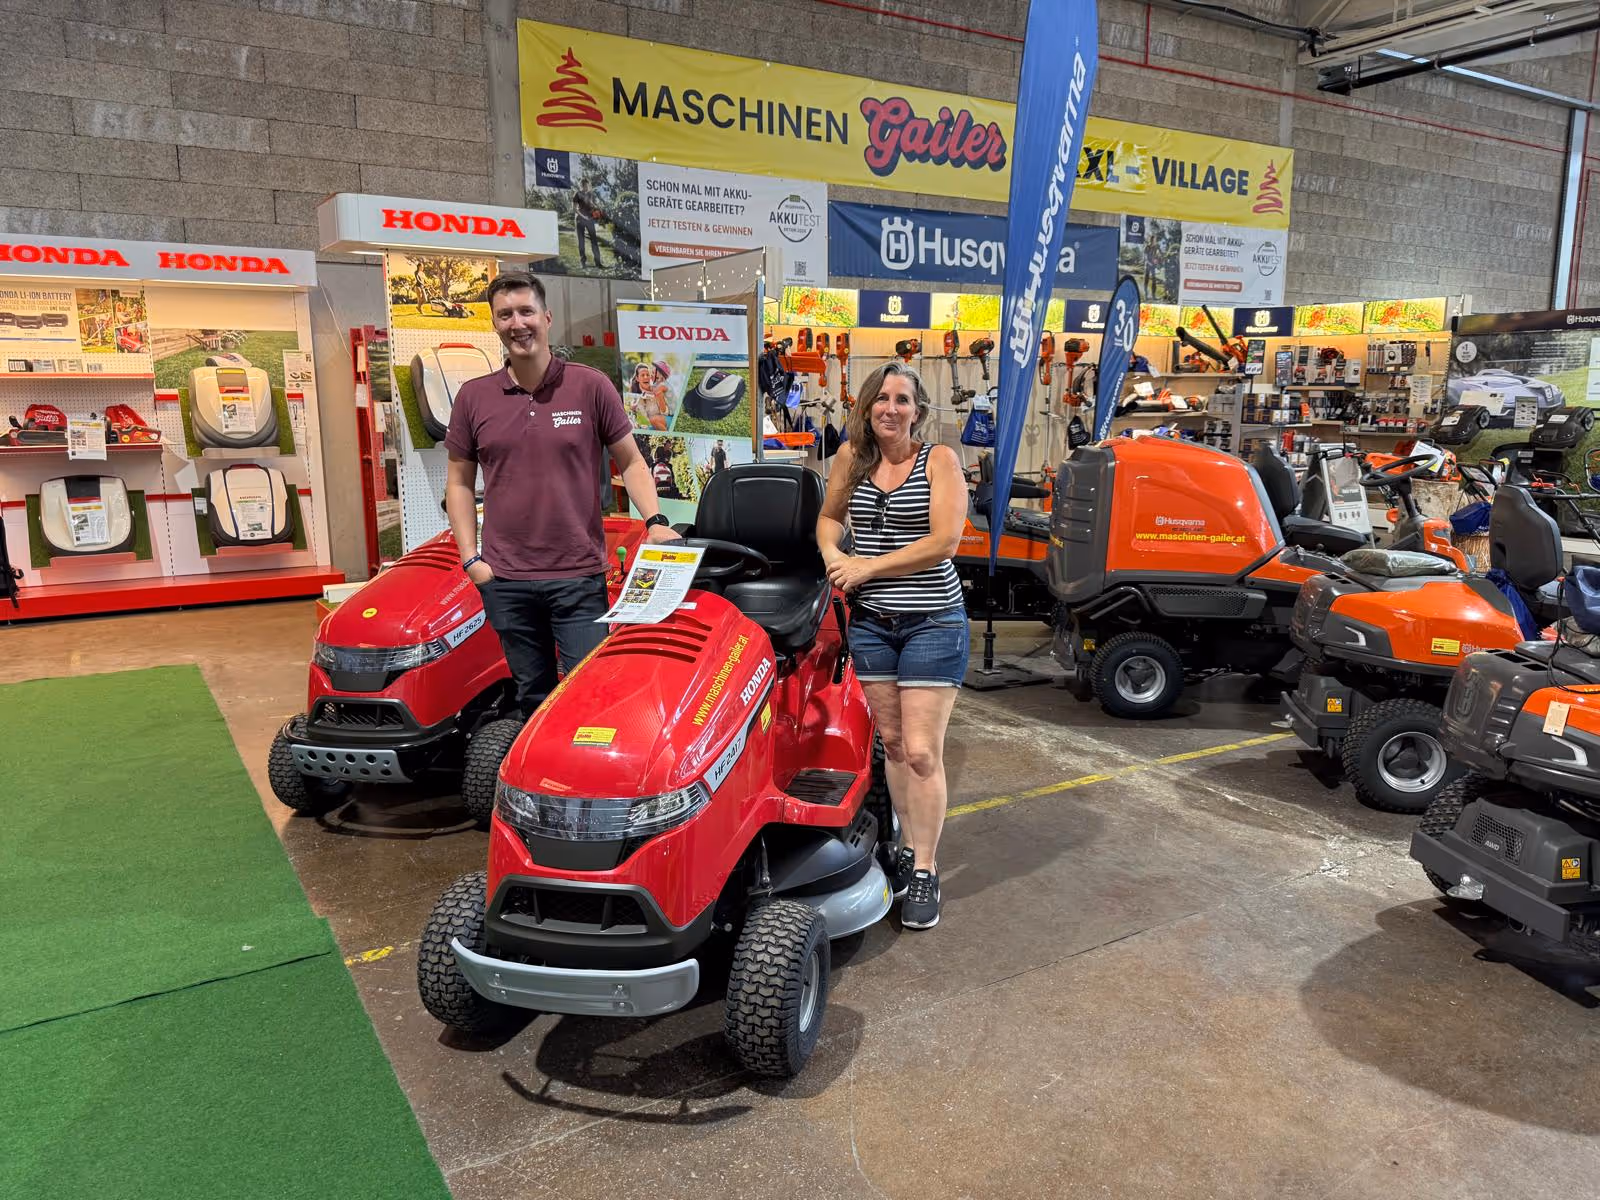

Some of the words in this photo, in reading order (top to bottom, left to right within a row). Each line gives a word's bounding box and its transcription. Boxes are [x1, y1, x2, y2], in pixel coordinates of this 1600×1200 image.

[612, 77, 849, 145] MASCHINEN
[860, 96, 1006, 177] Gailer
[1152, 156, 1249, 196] VILLAGE
[646, 179, 680, 193] SCHON
[682, 183, 702, 196] MAL
[704, 186, 722, 198] MIT
[723, 187, 753, 200] AKKU-
[647, 196, 683, 210] GERÄTE
[685, 199, 745, 216] GEARBEITET?
[382, 209, 526, 238] HONDA
[648, 218, 670, 229] JETZT
[673, 221, 702, 232] TESTEN
[712, 226, 753, 236] GEWINNEN
[769, 211, 822, 228] AKKUTEST
[655, 244, 695, 255] VEREINBAREN
[918, 226, 1075, 275] Husqa
[158, 251, 291, 275] HONDA
[0, 290, 19, 299] ONDA
[20, 290, 41, 300] LI-ION
[42, 292, 72, 301] BATTERY
[638, 325, 730, 342] HONDA
[553, 416, 582, 428] Gailer
[1136, 532, 1246, 543] www.maschinen-gailer.at
[453, 629, 464, 643] HF
[692, 634, 749, 726] www.maschinen-gailer.at
[740, 657, 772, 706] HONDA
[714, 764, 726, 782] HF
[1484, 840, 1500, 851] AWD
